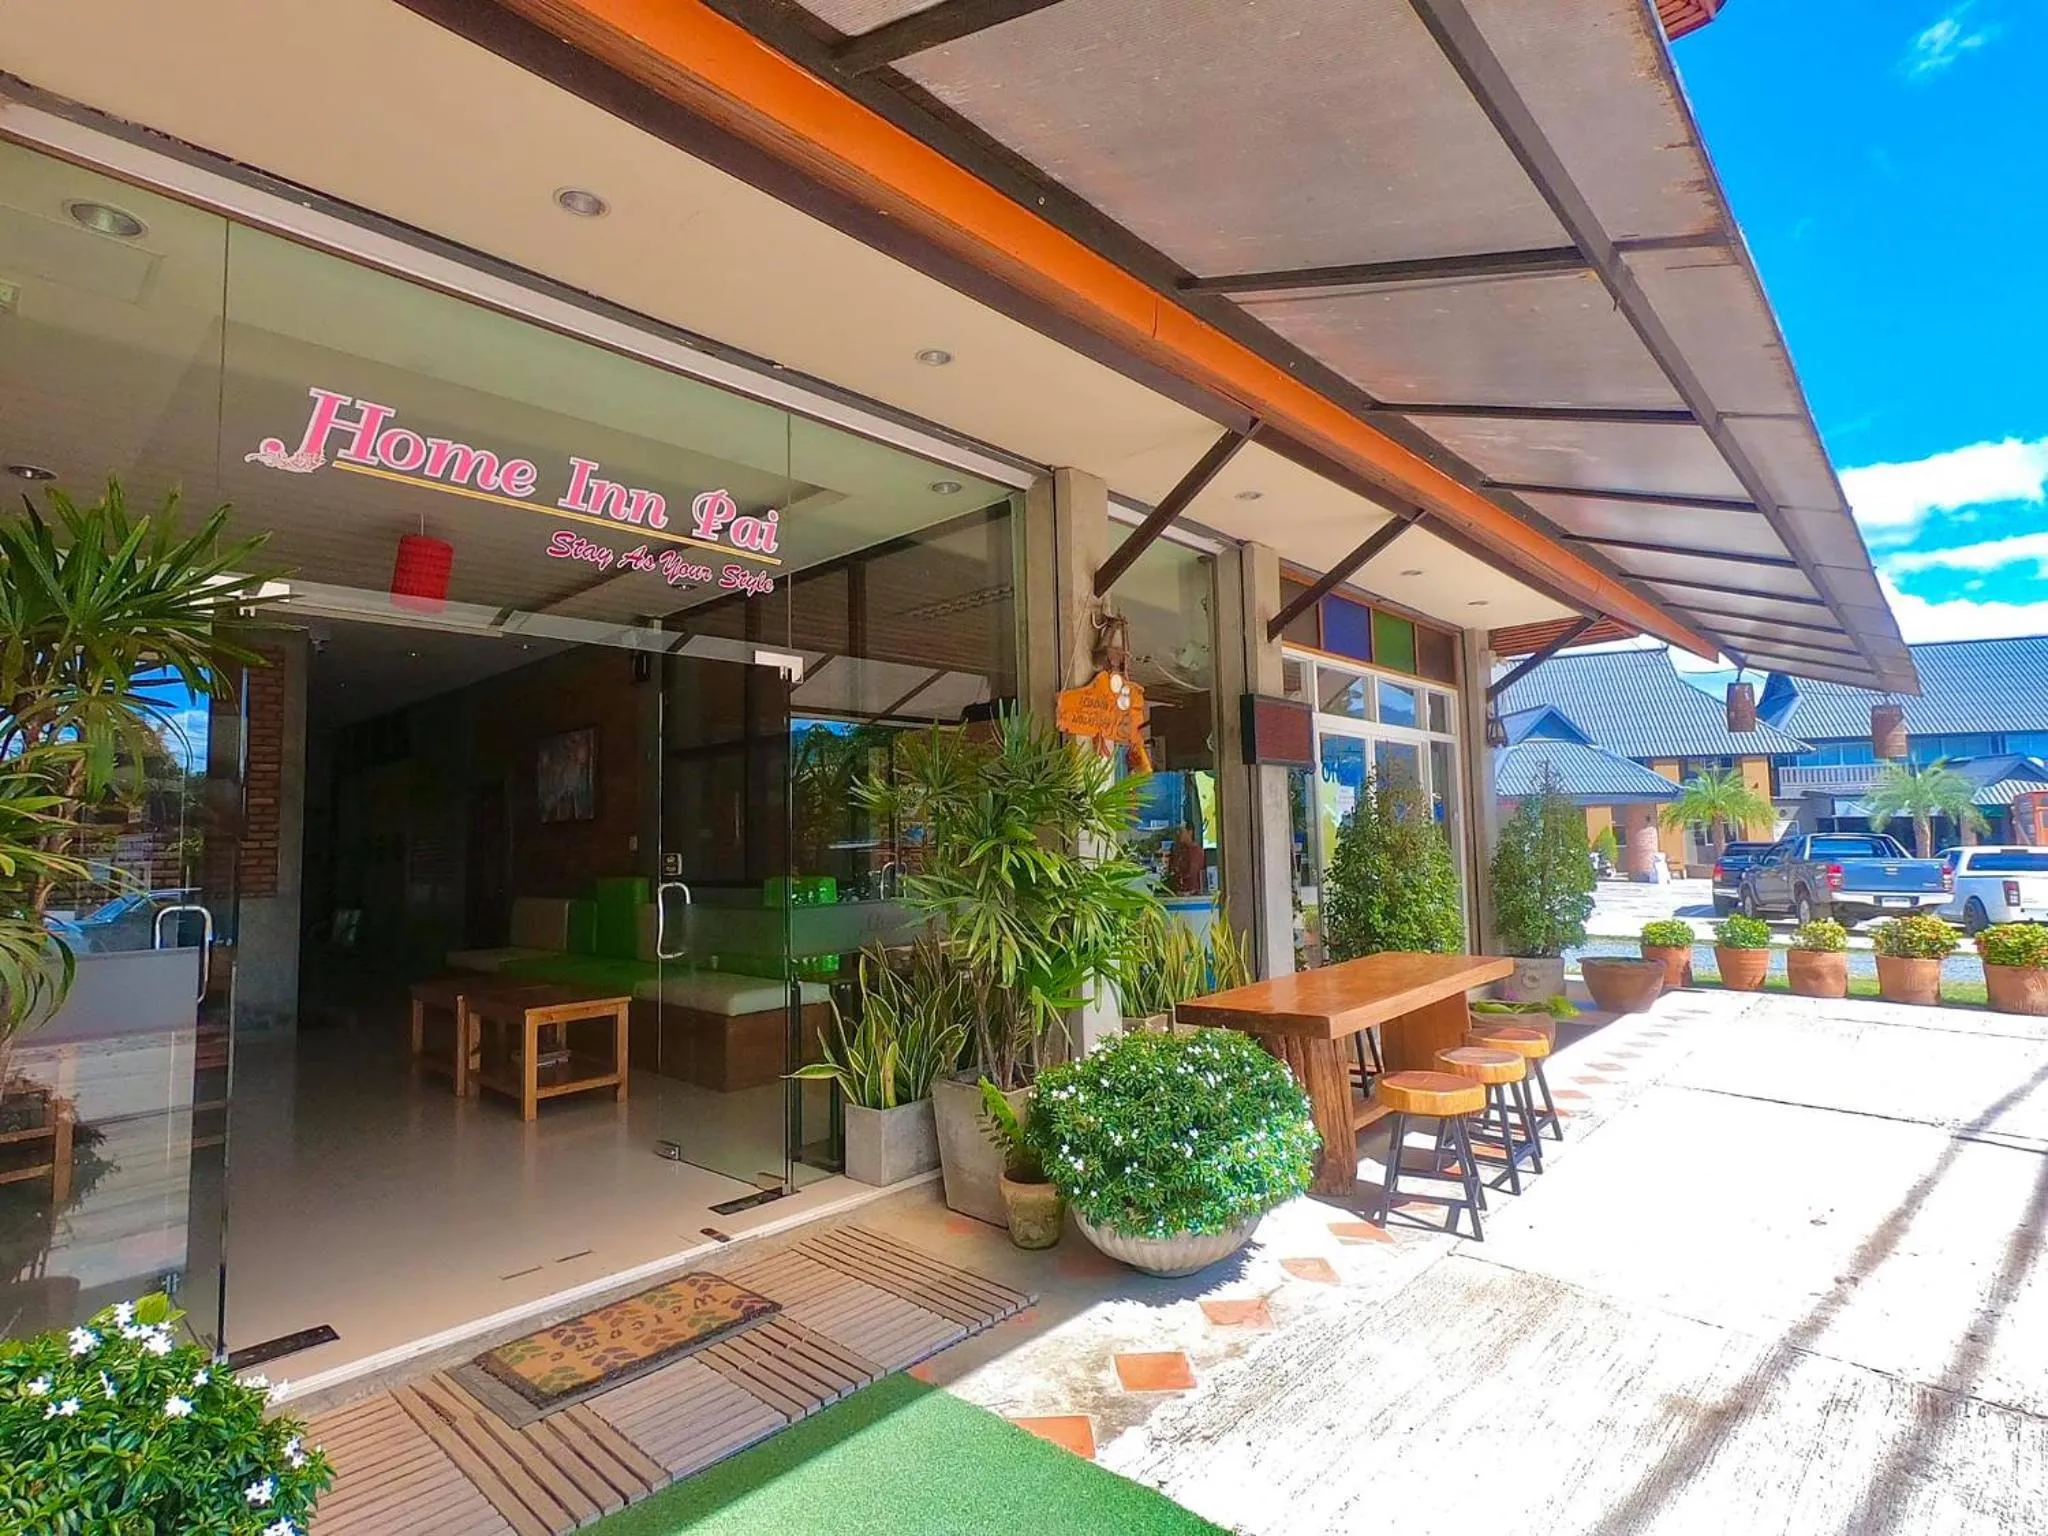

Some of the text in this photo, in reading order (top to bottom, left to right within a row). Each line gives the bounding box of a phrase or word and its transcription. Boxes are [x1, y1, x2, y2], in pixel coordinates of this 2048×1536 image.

[244, 387, 780, 554] Home Inn Pai
[546, 530, 775, 597] Stay As Your Style
